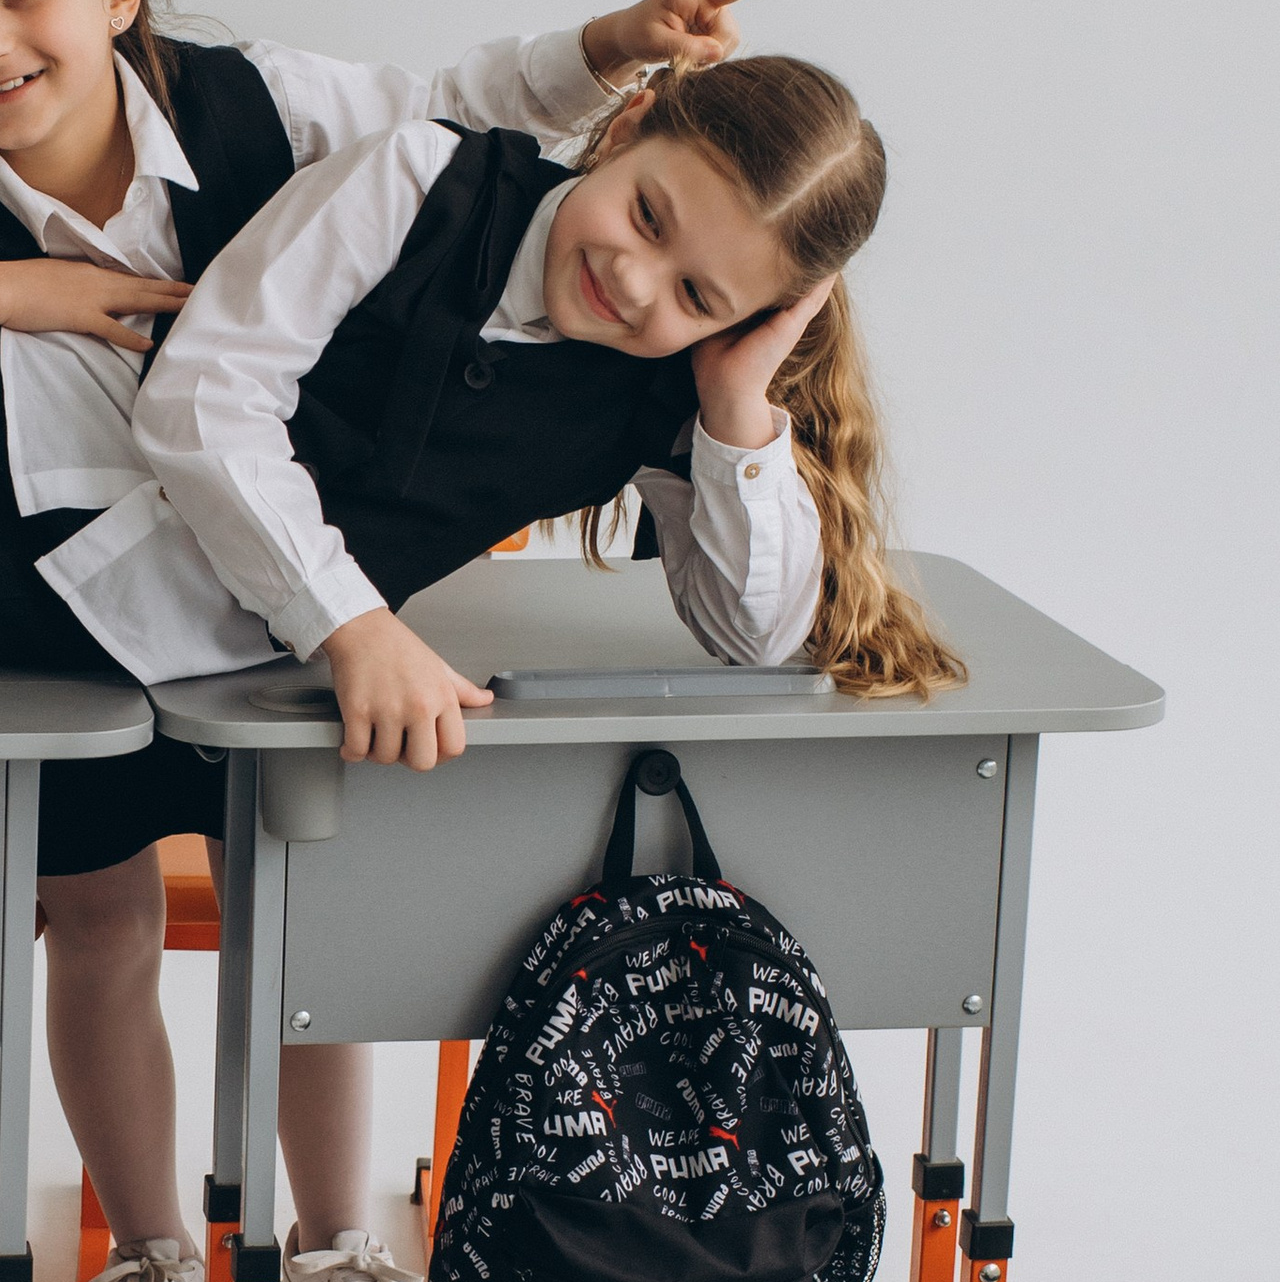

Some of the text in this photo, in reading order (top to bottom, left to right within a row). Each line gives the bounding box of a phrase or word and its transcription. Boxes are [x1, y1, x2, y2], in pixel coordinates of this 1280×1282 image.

[656, 886, 741, 914] PUMA
[523, 913, 568, 972] WE ARE
[625, 950, 652, 968] WE
[753, 962, 780, 983] WE
[748, 986, 820, 1037] PUMA
[603, 1003, 659, 1063] BRAVE
[660, 1031, 693, 1049] COOL
[699, 1027, 725, 1065] PUMA
[722, 1016, 747, 1044] COOL
[768, 1042, 799, 1058] PUM
[800, 1042, 817, 1075] COOL
[544, 1050, 572, 1088] COOL
[581, 1048, 613, 1101] BRAVE
[607, 1063, 624, 1096] COOL
[792, 1069, 838, 1098] BRAV
[514, 1072, 537, 1145] BRAVE
[676, 1078, 706, 1125] PUMA
[701, 1081, 739, 1130] BRAVE
[543, 1110, 607, 1137] UMA
[648, 1128, 701, 1147] WE ARE
[781, 1123, 810, 1145] WE
[566, 1149, 606, 1184] PUMA
[605, 1141, 622, 1173] COOL
[649, 1145, 730, 1180] PUMA
[653, 1184, 687, 1207] COOL
[727, 1168, 749, 1197] COOL
[793, 1172, 830, 1197] COOL
